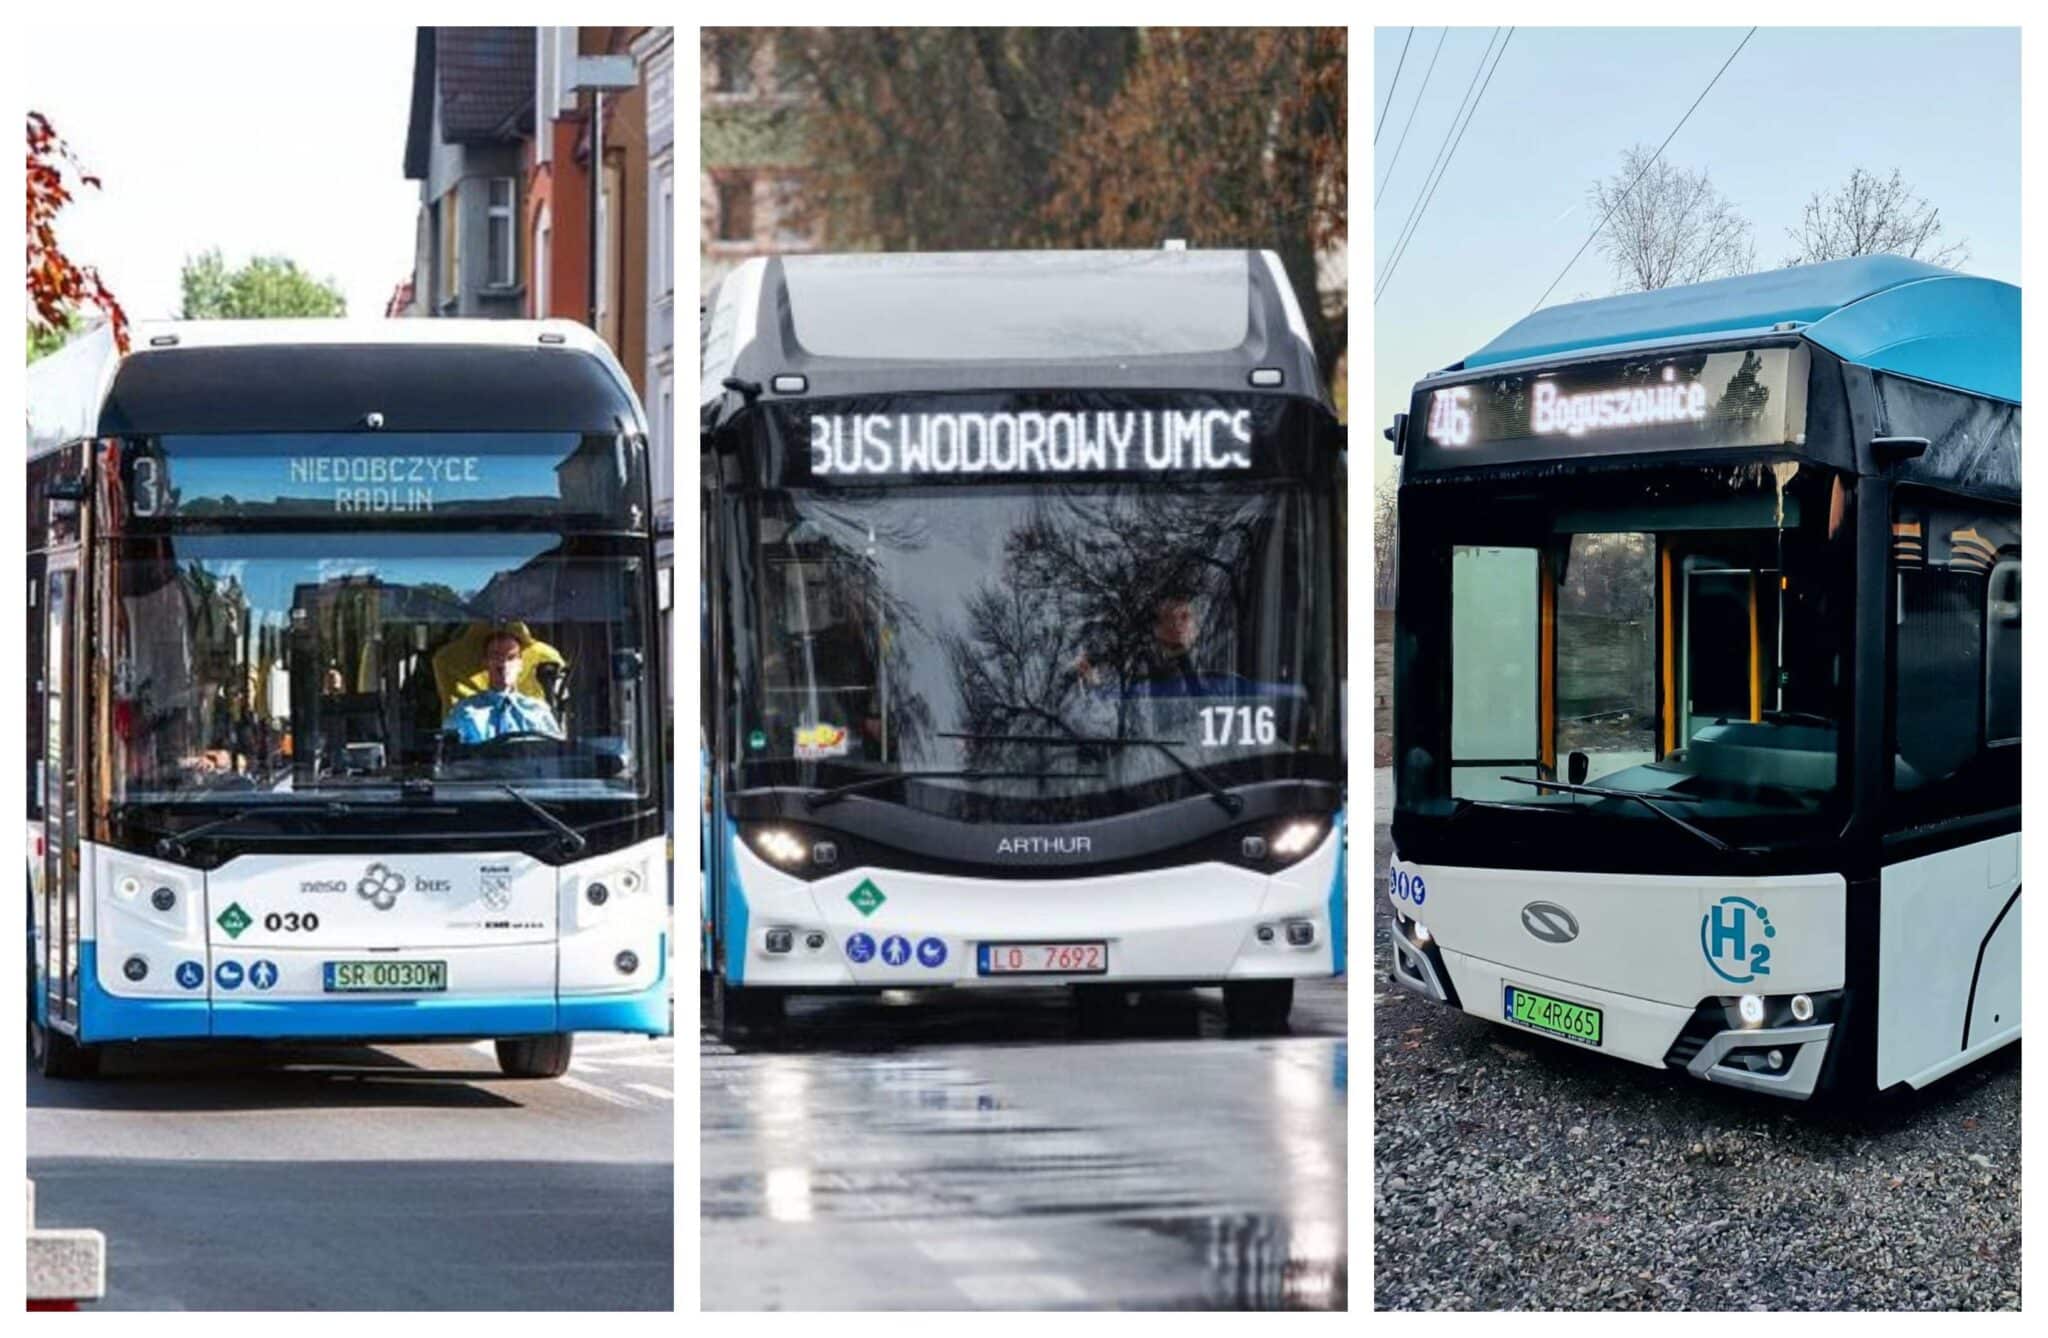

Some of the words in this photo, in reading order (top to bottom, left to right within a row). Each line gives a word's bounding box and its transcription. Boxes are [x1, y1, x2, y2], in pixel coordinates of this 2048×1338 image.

[1428, 386, 1472, 446] 46
[1533, 365, 1706, 436] Boguszowice
[810, 413, 893, 475] BUS
[900, 409, 1135, 474] WODOROWY
[290, 456, 480, 483] NIEDOBCZYCE
[133, 456, 158, 517] 3
[335, 487, 434, 513] RADLIN
[1200, 705, 1275, 746] 1716
[996, 836, 1092, 854] ARTHUR
[300, 880, 348, 893] neso
[415, 875, 451, 892] bus
[264, 911, 320, 933] 030
[1044, 946, 1100, 969] 7692
[338, 964, 366, 986] SR
[373, 963, 441, 985] 0030W
[1516, 993, 1537, 1021] PZ
[1543, 1001, 1595, 1036] 4R665
